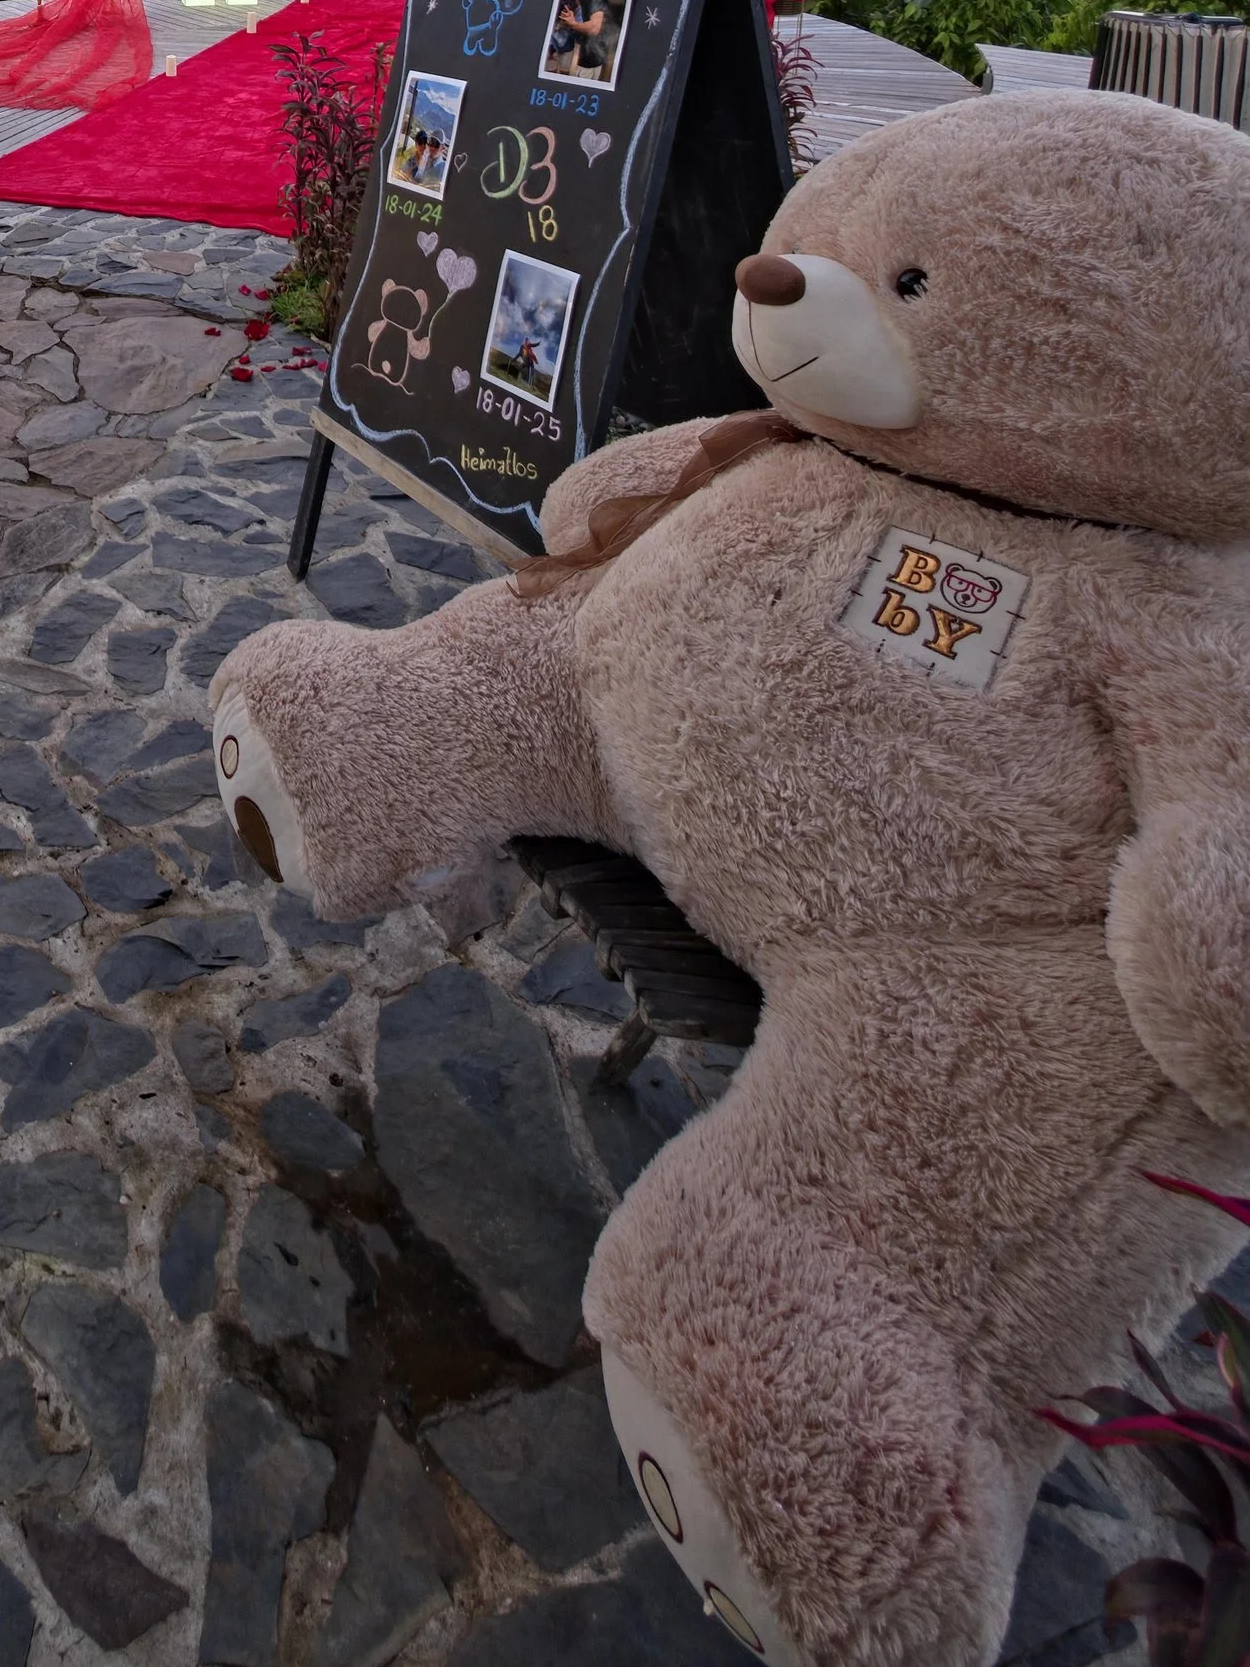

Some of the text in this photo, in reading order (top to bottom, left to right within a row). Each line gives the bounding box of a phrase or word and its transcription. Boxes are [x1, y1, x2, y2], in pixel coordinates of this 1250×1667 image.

[529, 87, 600, 117] 18-01-23
[384, 194, 443, 227] 18-01-24
[527, 204, 559, 243] 18
[476, 385, 562, 441] 18-01-25
